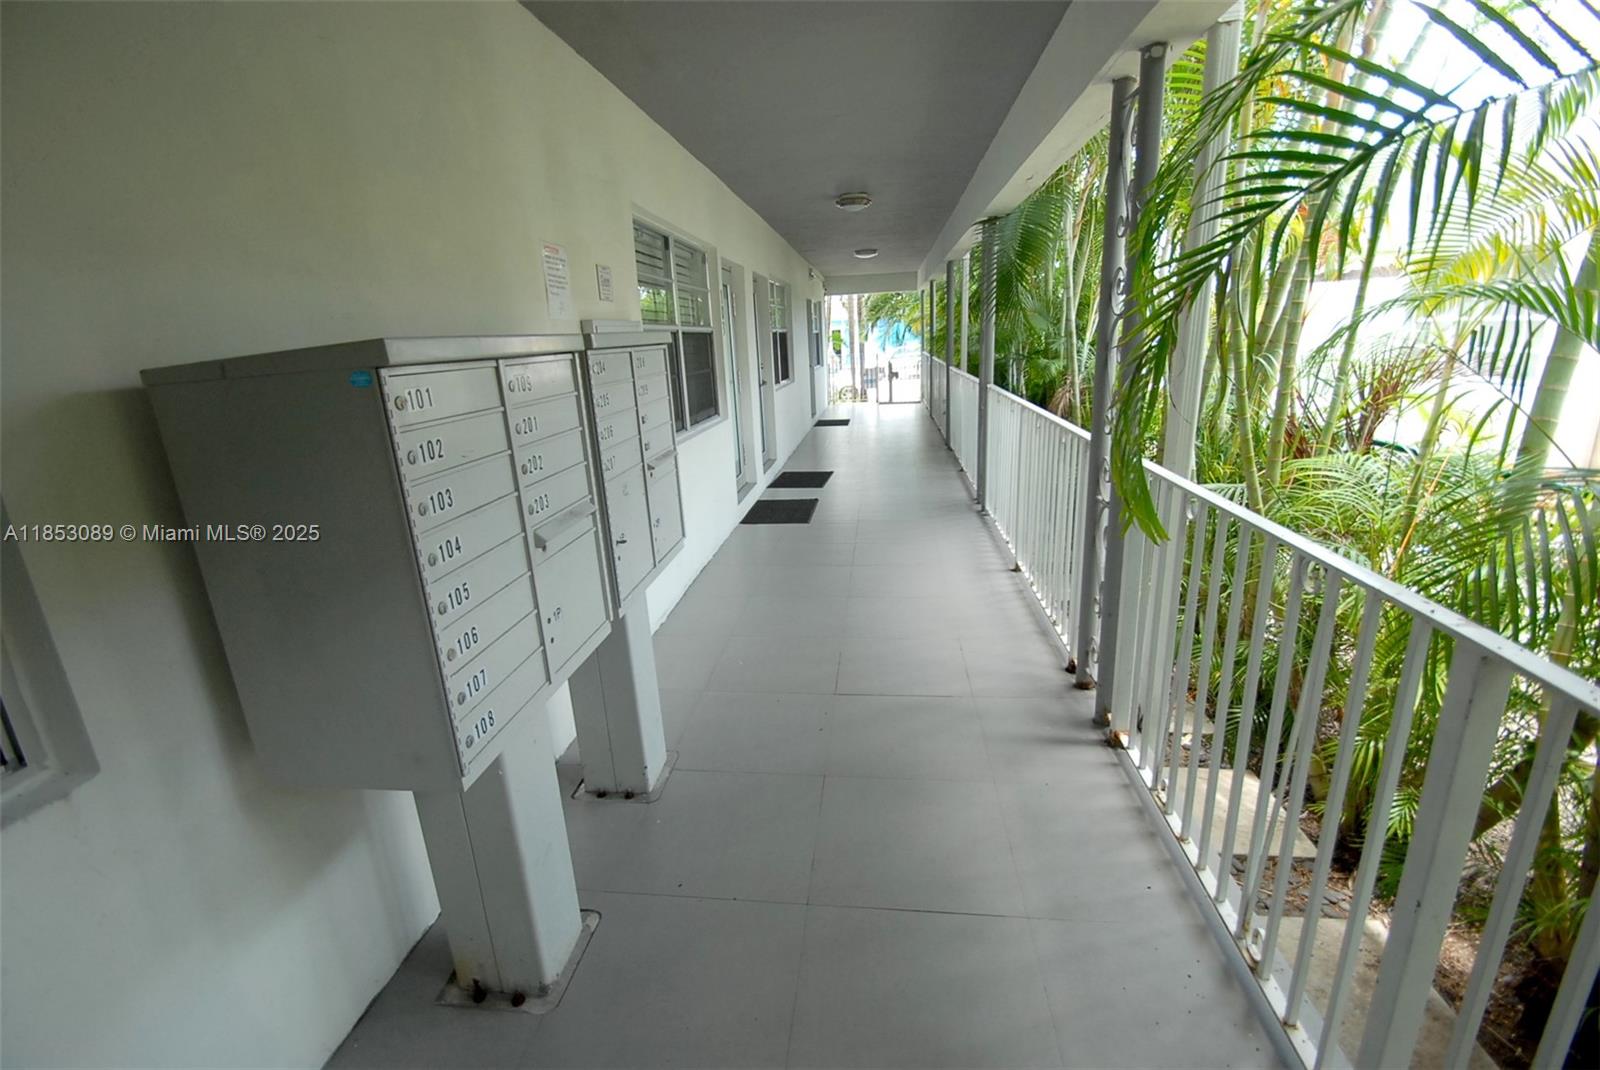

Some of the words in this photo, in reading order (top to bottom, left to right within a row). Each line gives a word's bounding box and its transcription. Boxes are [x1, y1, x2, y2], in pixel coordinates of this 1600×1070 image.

[407, 387, 433, 411] 101
[522, 416, 539, 435] 201
[419, 438, 444, 463] 102
[528, 455, 544, 474] 202
[430, 488, 454, 514] 103
[535, 493, 550, 514] 203
[438, 536, 462, 563] 104
[448, 582, 471, 611] 105
[457, 626, 479, 654] 106
[466, 669, 487, 698] 107
[474, 710, 496, 740] 108
